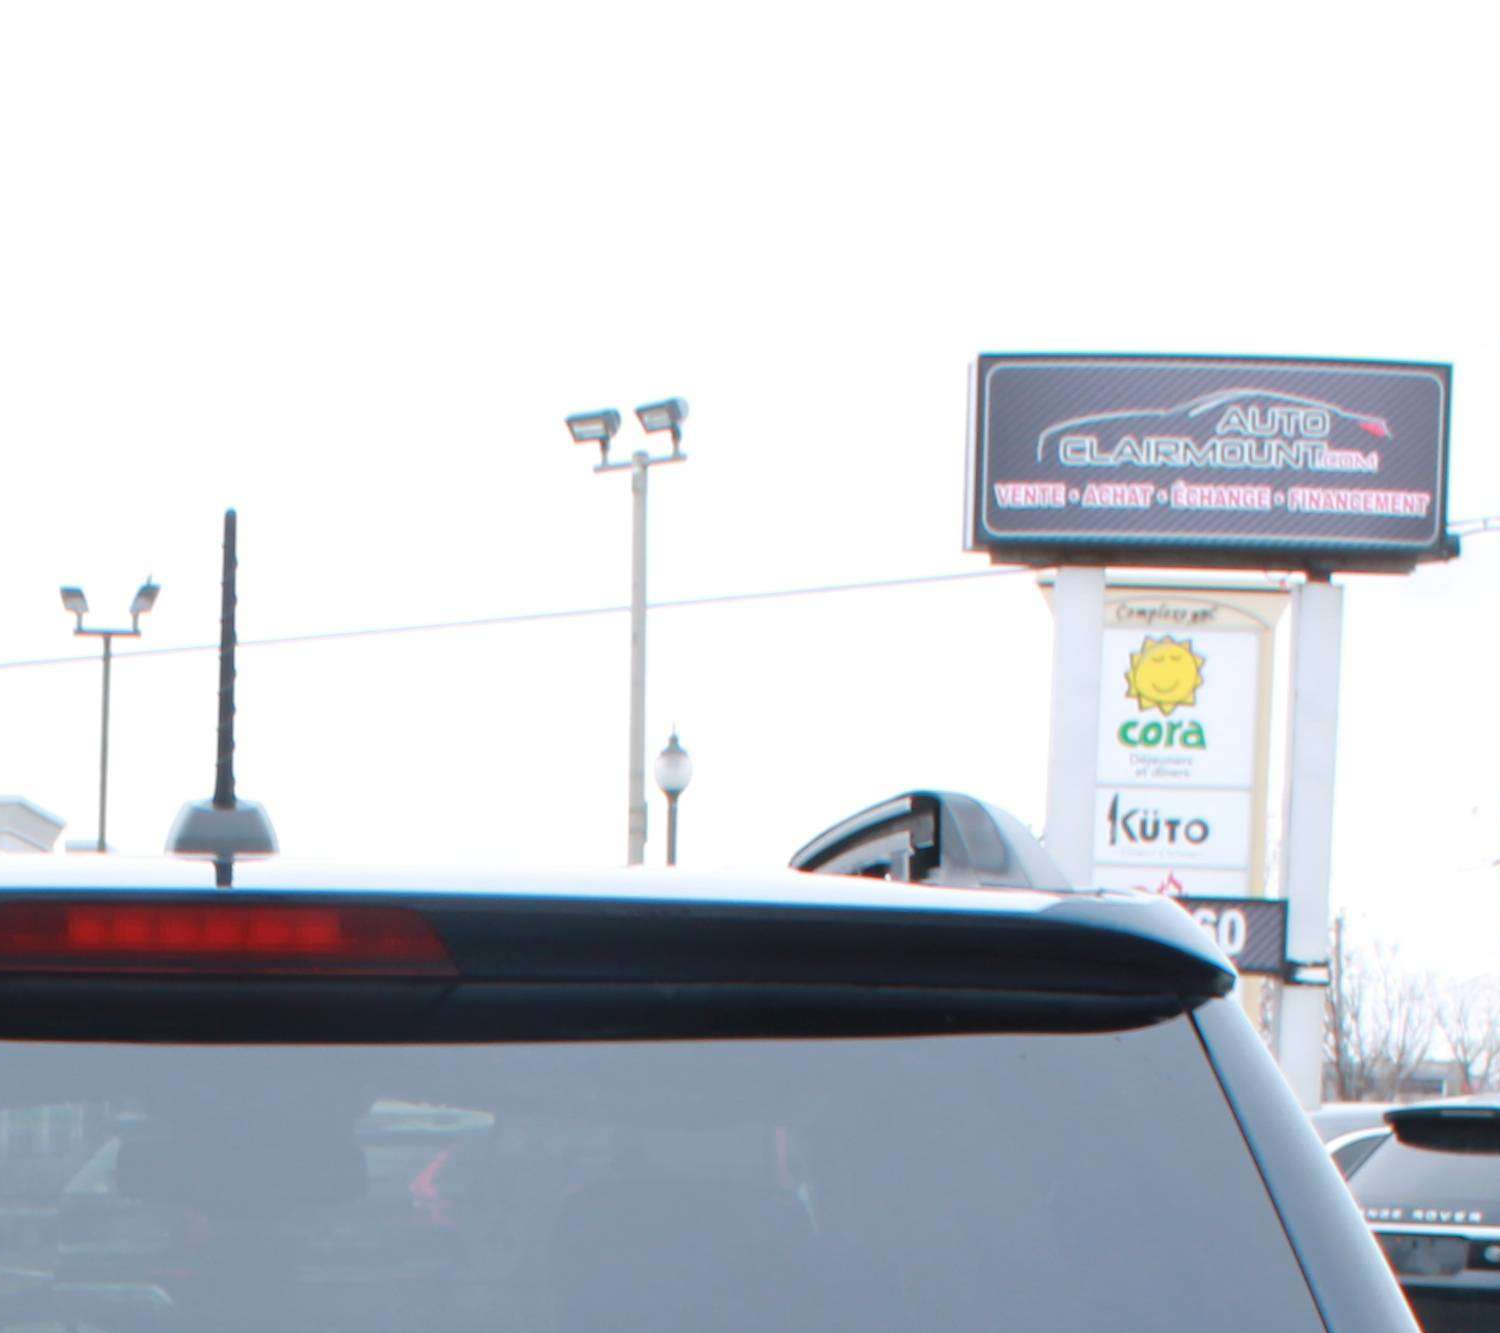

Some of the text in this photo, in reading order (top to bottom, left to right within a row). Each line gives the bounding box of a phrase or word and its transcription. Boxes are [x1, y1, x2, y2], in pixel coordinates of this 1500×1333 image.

[1216, 406, 1331, 438] AUTO
[995, 480, 1430, 517] VENTE ACHAT ÉCHANGE FINANCEMENT
[1118, 719, 1207, 750] cora
